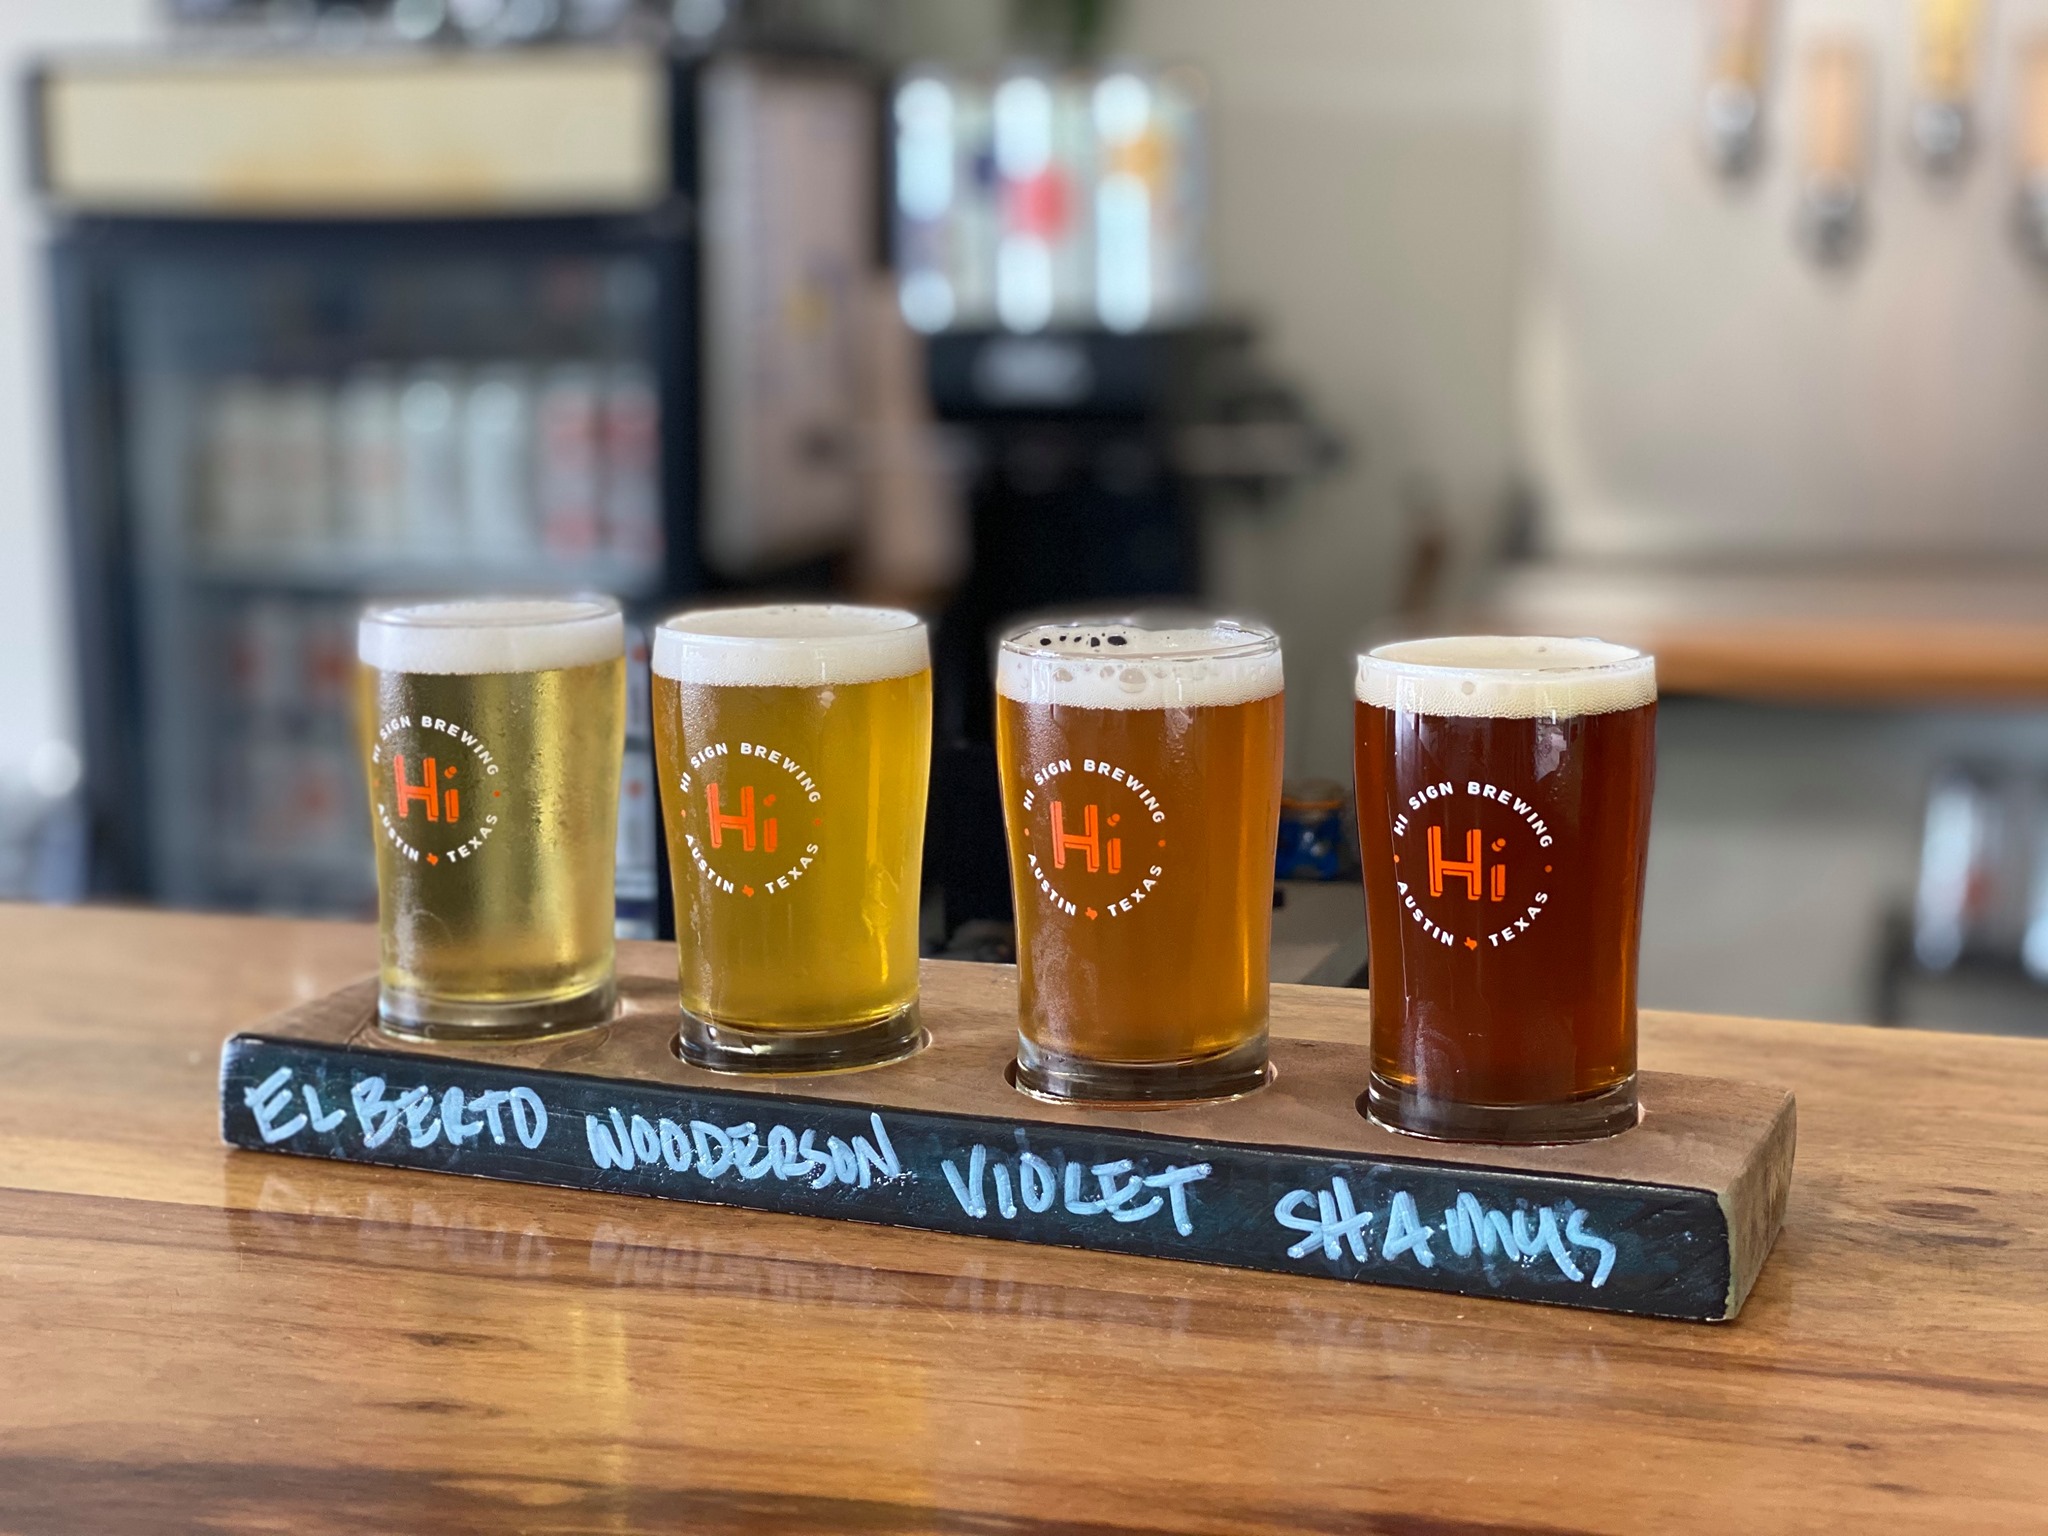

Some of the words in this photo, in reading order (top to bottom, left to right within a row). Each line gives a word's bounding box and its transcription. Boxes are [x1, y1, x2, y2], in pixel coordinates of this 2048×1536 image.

[380, 715, 411, 741] SIGN
[421, 715, 499, 775] BREWING
[680, 772, 692, 793] HI
[691, 742, 728, 769] SIGN
[740, 742, 821, 803] BREWING
[394, 754, 459, 823] Hi
[706, 782, 778, 853] Hi
[1023, 789, 1035, 811] HI
[1034, 759, 1072, 786] SIGN
[1083, 759, 1165, 823] BREWING
[1393, 813, 1408, 837] HI
[1408, 781, 1454, 810] SIGN
[1467, 781, 1553, 848] BREWING
[378, 803, 419, 862] AUSTIN
[446, 814, 498, 863] TEXAS
[685, 834, 734, 894] AUSTIN
[765, 843, 819, 894] TEXAS
[1050, 800, 1121, 874] Hi
[1427, 825, 1506, 902] Hi
[1028, 853, 1076, 916] AUSTIN
[1107, 865, 1163, 917] TEXAS
[1397, 881, 1454, 946] AUSTIN
[1488, 892, 1548, 947] TEXAS
[586, 1107, 901, 1190] WOODERSON
[941, 1143, 1213, 1238] VIOLET
